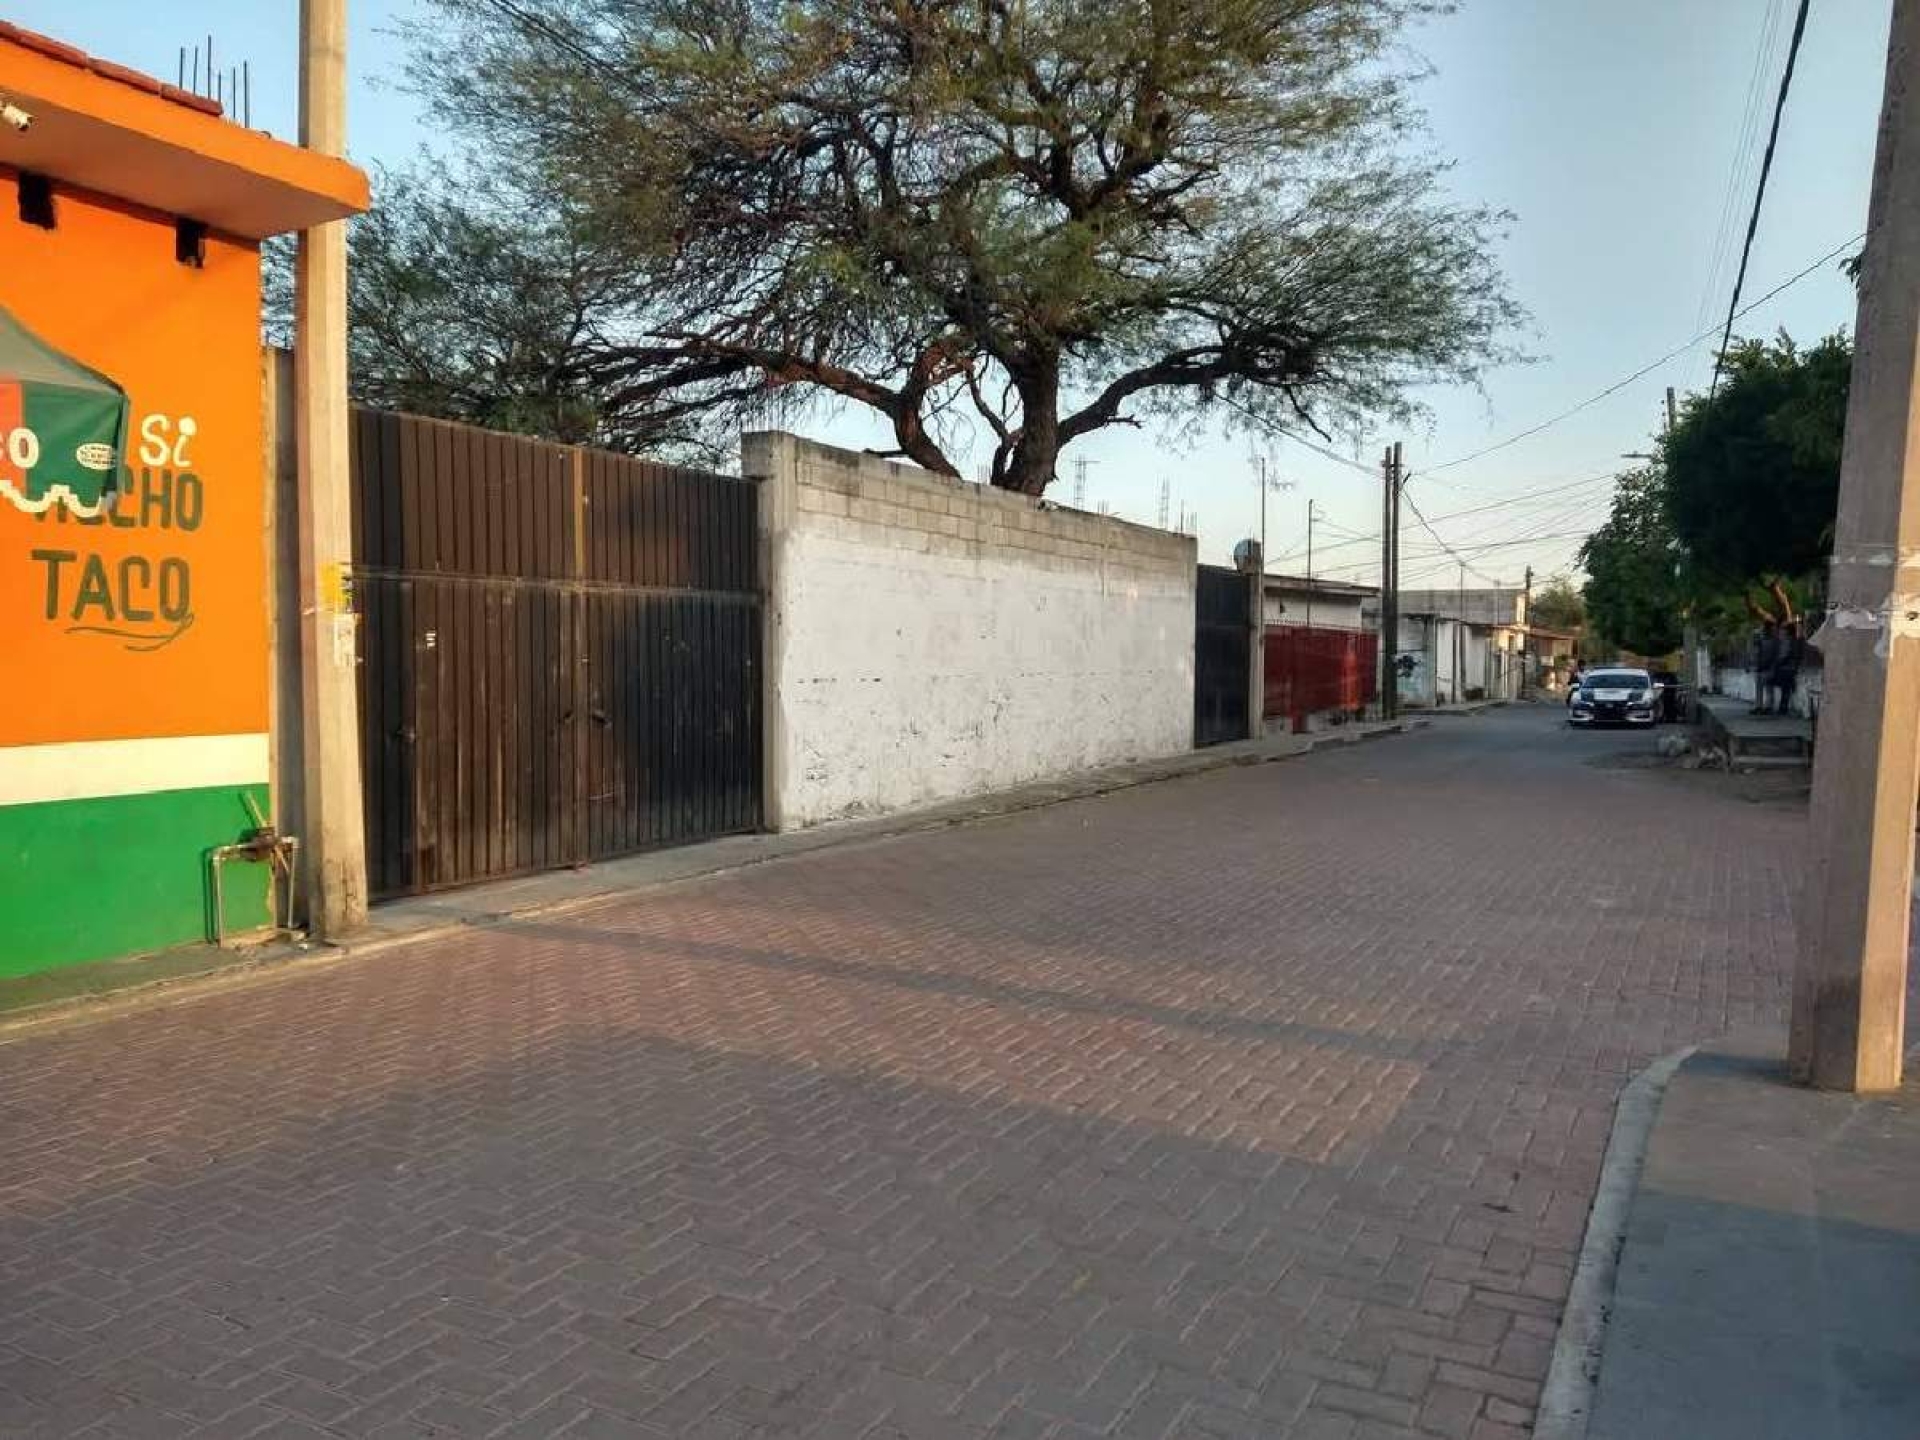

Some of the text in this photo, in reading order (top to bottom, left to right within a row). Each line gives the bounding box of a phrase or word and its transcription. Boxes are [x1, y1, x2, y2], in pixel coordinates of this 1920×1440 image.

[0, 428, 39, 469] O
[34, 466, 204, 532] CHO
[31, 548, 191, 622] TACO
